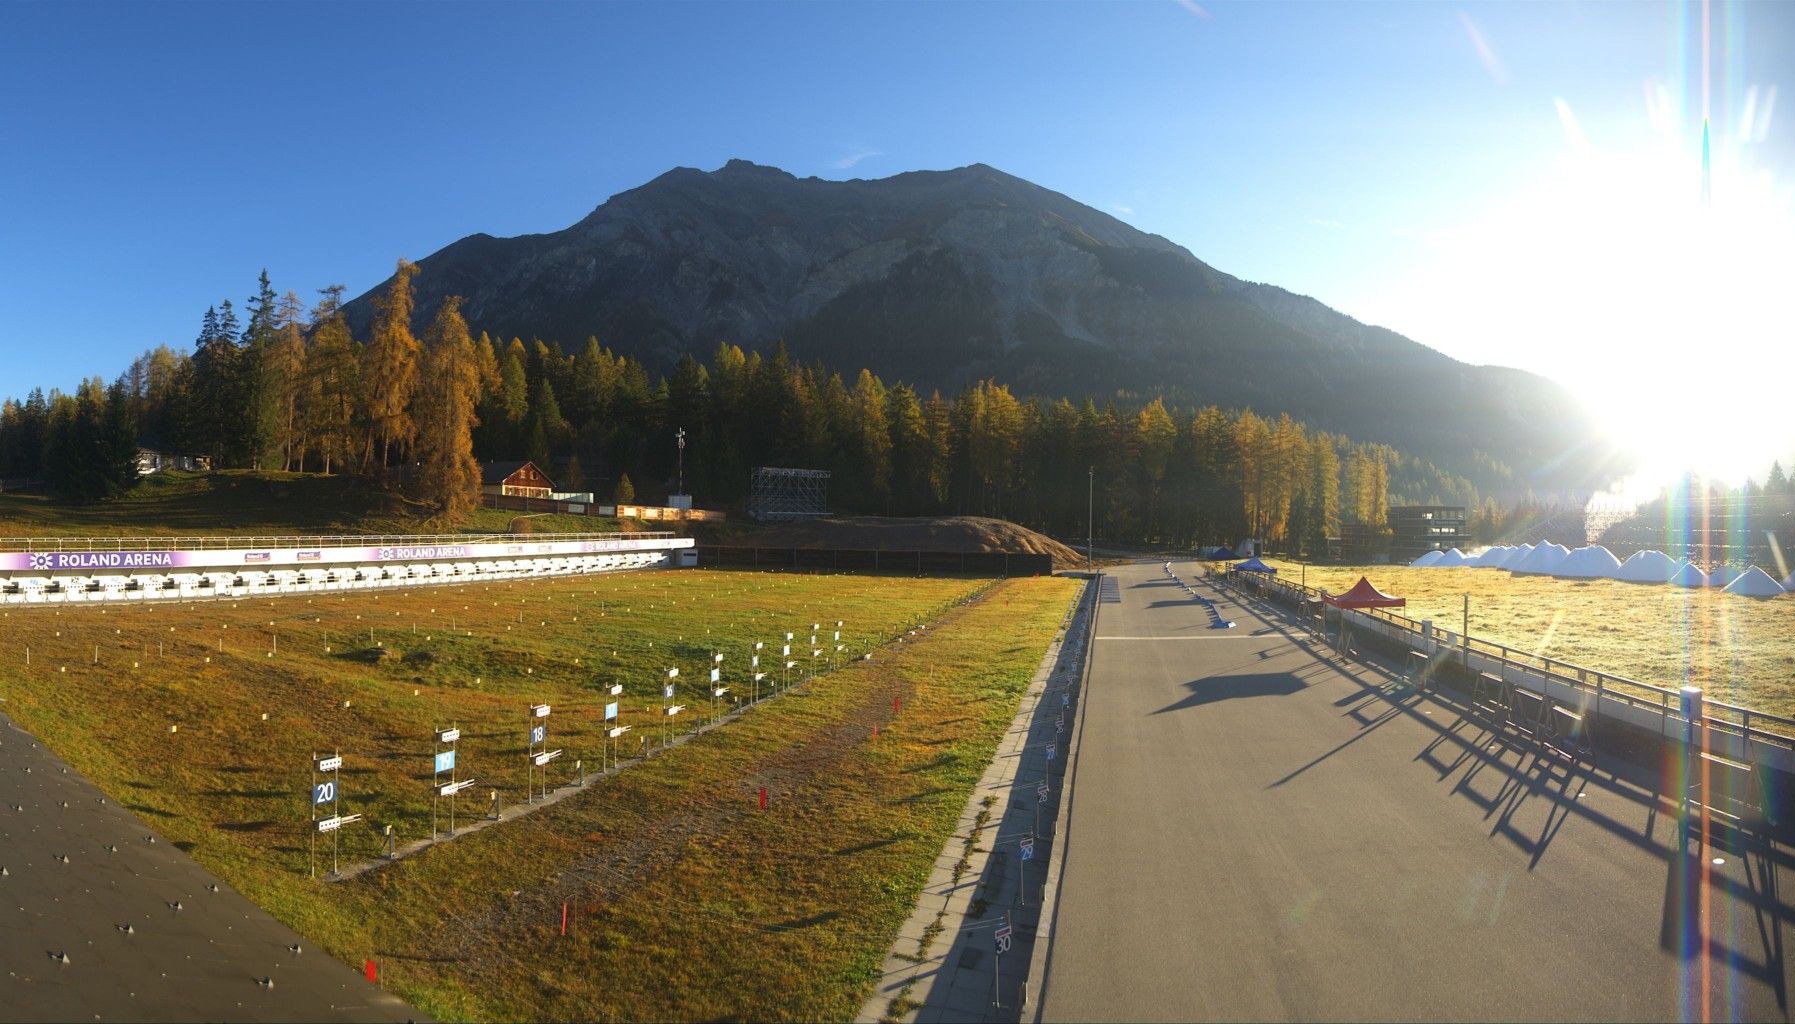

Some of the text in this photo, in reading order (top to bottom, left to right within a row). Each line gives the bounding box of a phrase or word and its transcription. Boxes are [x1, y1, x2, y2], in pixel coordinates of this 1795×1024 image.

[58, 553, 173, 567] ROLAND ARENA
[396, 547, 465, 559] ROLAND ARENA
[533, 726, 543, 742] 18
[317, 782, 334, 804] 20
[1021, 845, 1033, 860] 29
[996, 935, 1011, 955] 30
